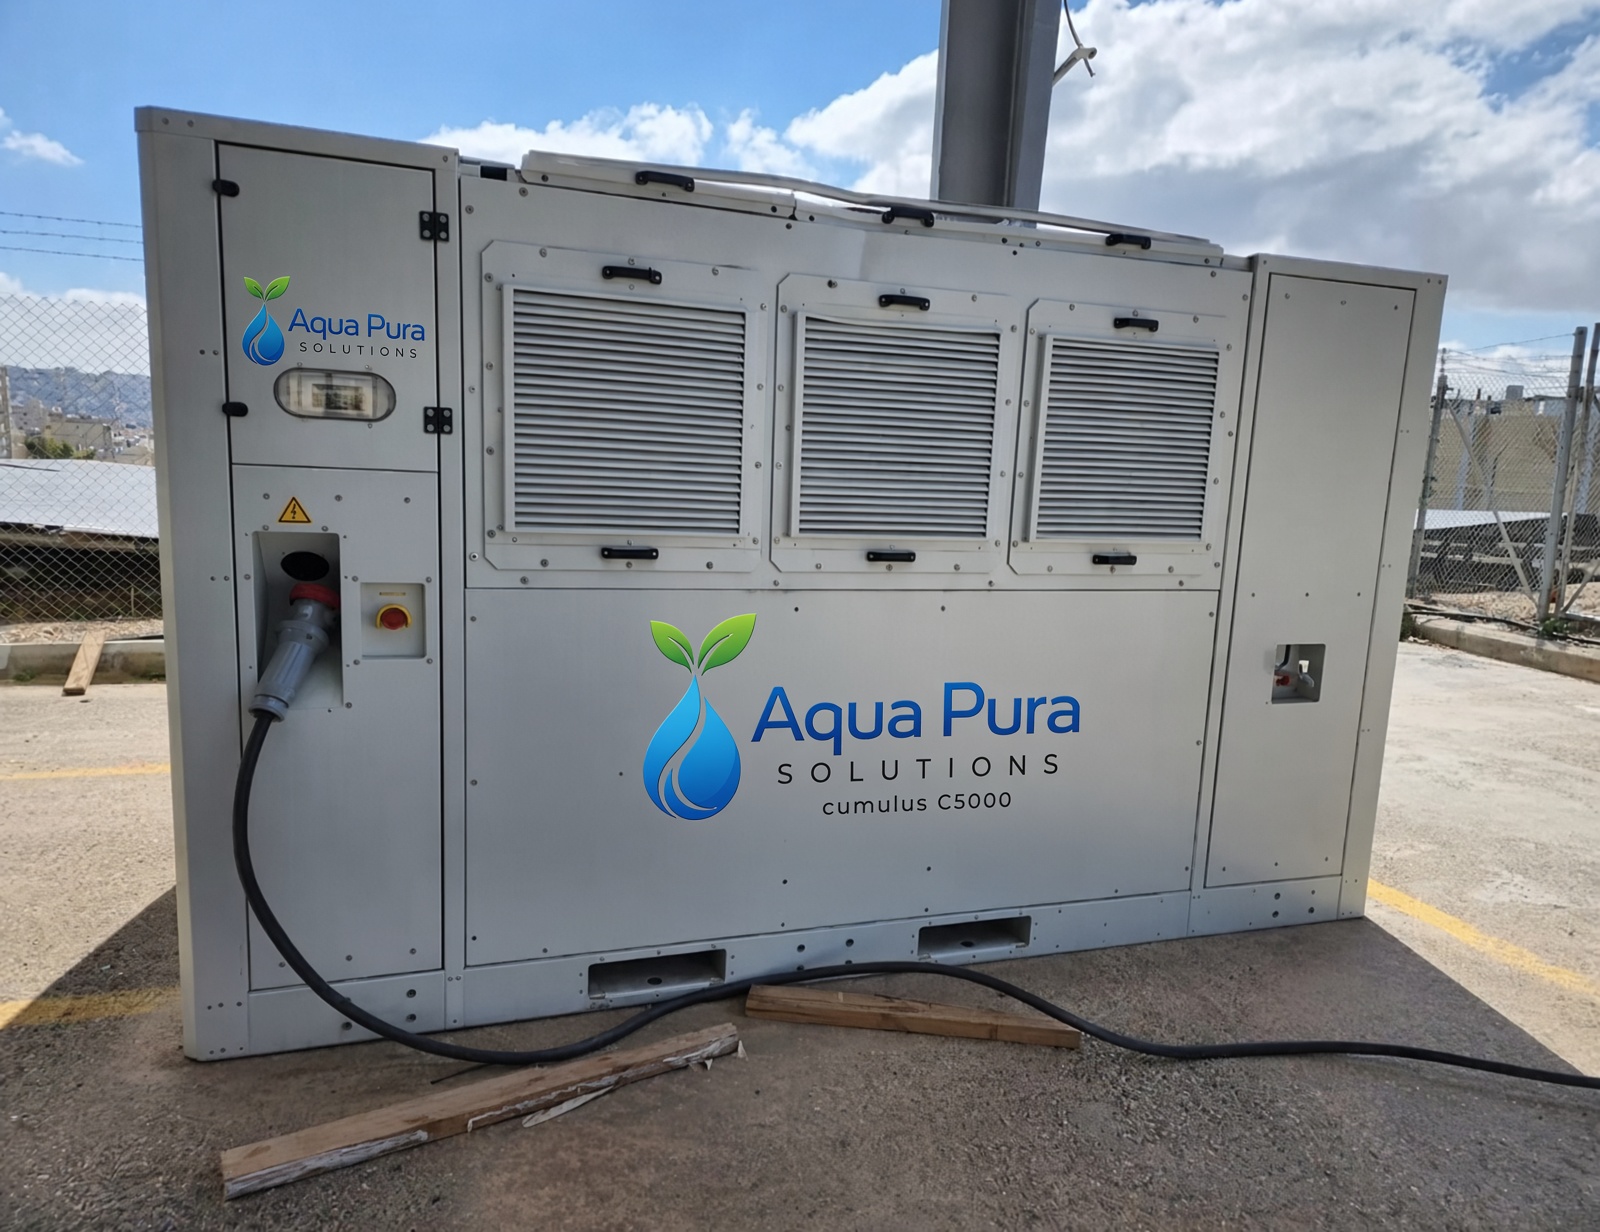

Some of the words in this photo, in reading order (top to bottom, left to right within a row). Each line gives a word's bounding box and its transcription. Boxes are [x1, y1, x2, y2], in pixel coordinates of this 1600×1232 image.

[288, 308, 359, 340] Aqua
[367, 313, 425, 341] Pura
[299, 341, 417, 359] SOLUTIONS
[751, 686, 922, 756] Aqua
[943, 681, 1080, 737] Pura
[777, 753, 1059, 784] SOLUTIONS
[822, 795, 928, 816] cumulus
[937, 791, 1012, 811] C5000
